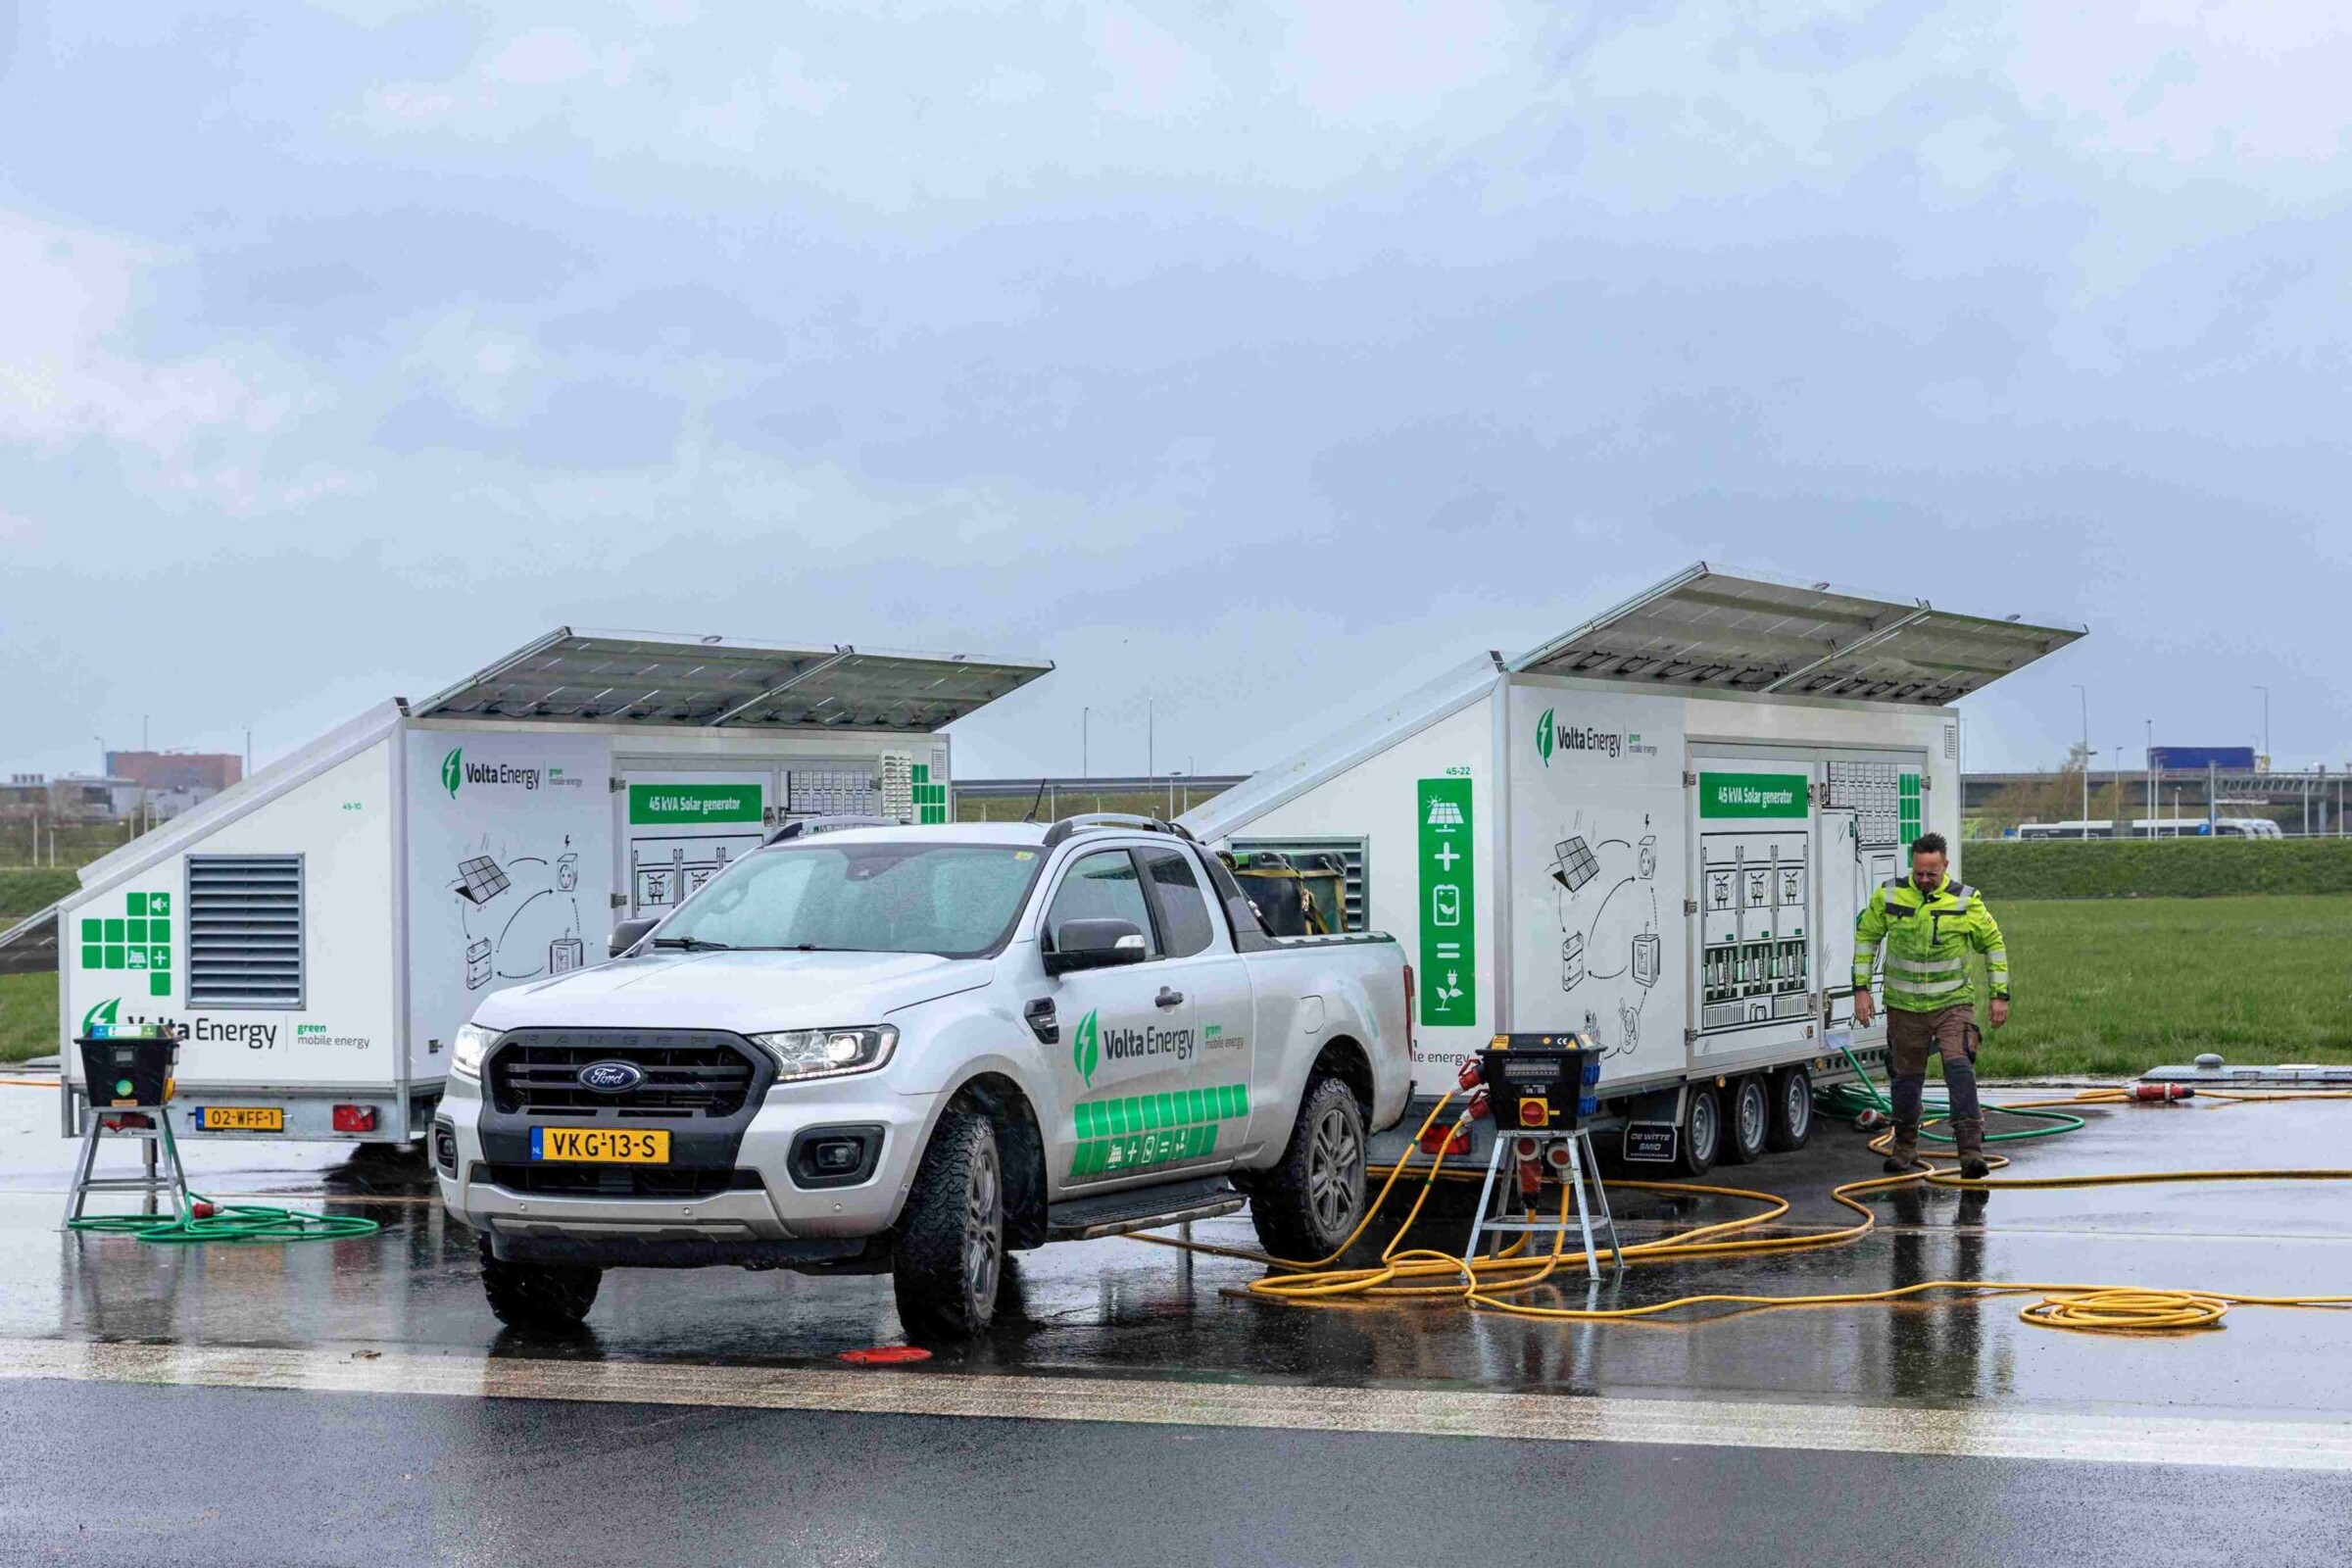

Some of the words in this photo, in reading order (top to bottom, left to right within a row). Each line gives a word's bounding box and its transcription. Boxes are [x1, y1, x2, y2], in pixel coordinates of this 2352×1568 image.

[1557, 725, 1586, 750] Volta
[1588, 727, 1621, 758] Energy
[466, 762, 498, 784] Volta
[500, 764, 540, 790] Energy
[1446, 766, 1471, 775] 45-22
[649, 796, 660, 811] 45
[662, 796, 678, 811] kVA
[680, 796, 701, 811] Solar
[703, 797, 741, 815] generator
[1718, 787, 1728, 804] 45
[1729, 787, 1742, 804] kVA
[1743, 787, 1761, 804] Solar
[1762, 789, 1792, 808] generator
[196, 1017, 277, 1050] Energy
[297, 1023, 327, 1035] green
[297, 1035, 332, 1046] mobile
[334, 1037, 370, 1049] energy
[1103, 1028, 1145, 1060] Volta
[1147, 1025, 1195, 1060] Energy
[1225, 1037, 1244, 1051] energy
[591, 1067, 624, 1086] Ford
[212, 1110, 274, 1125] 02-WFF-1
[552, 1132, 656, 1157] VKG-13-S
